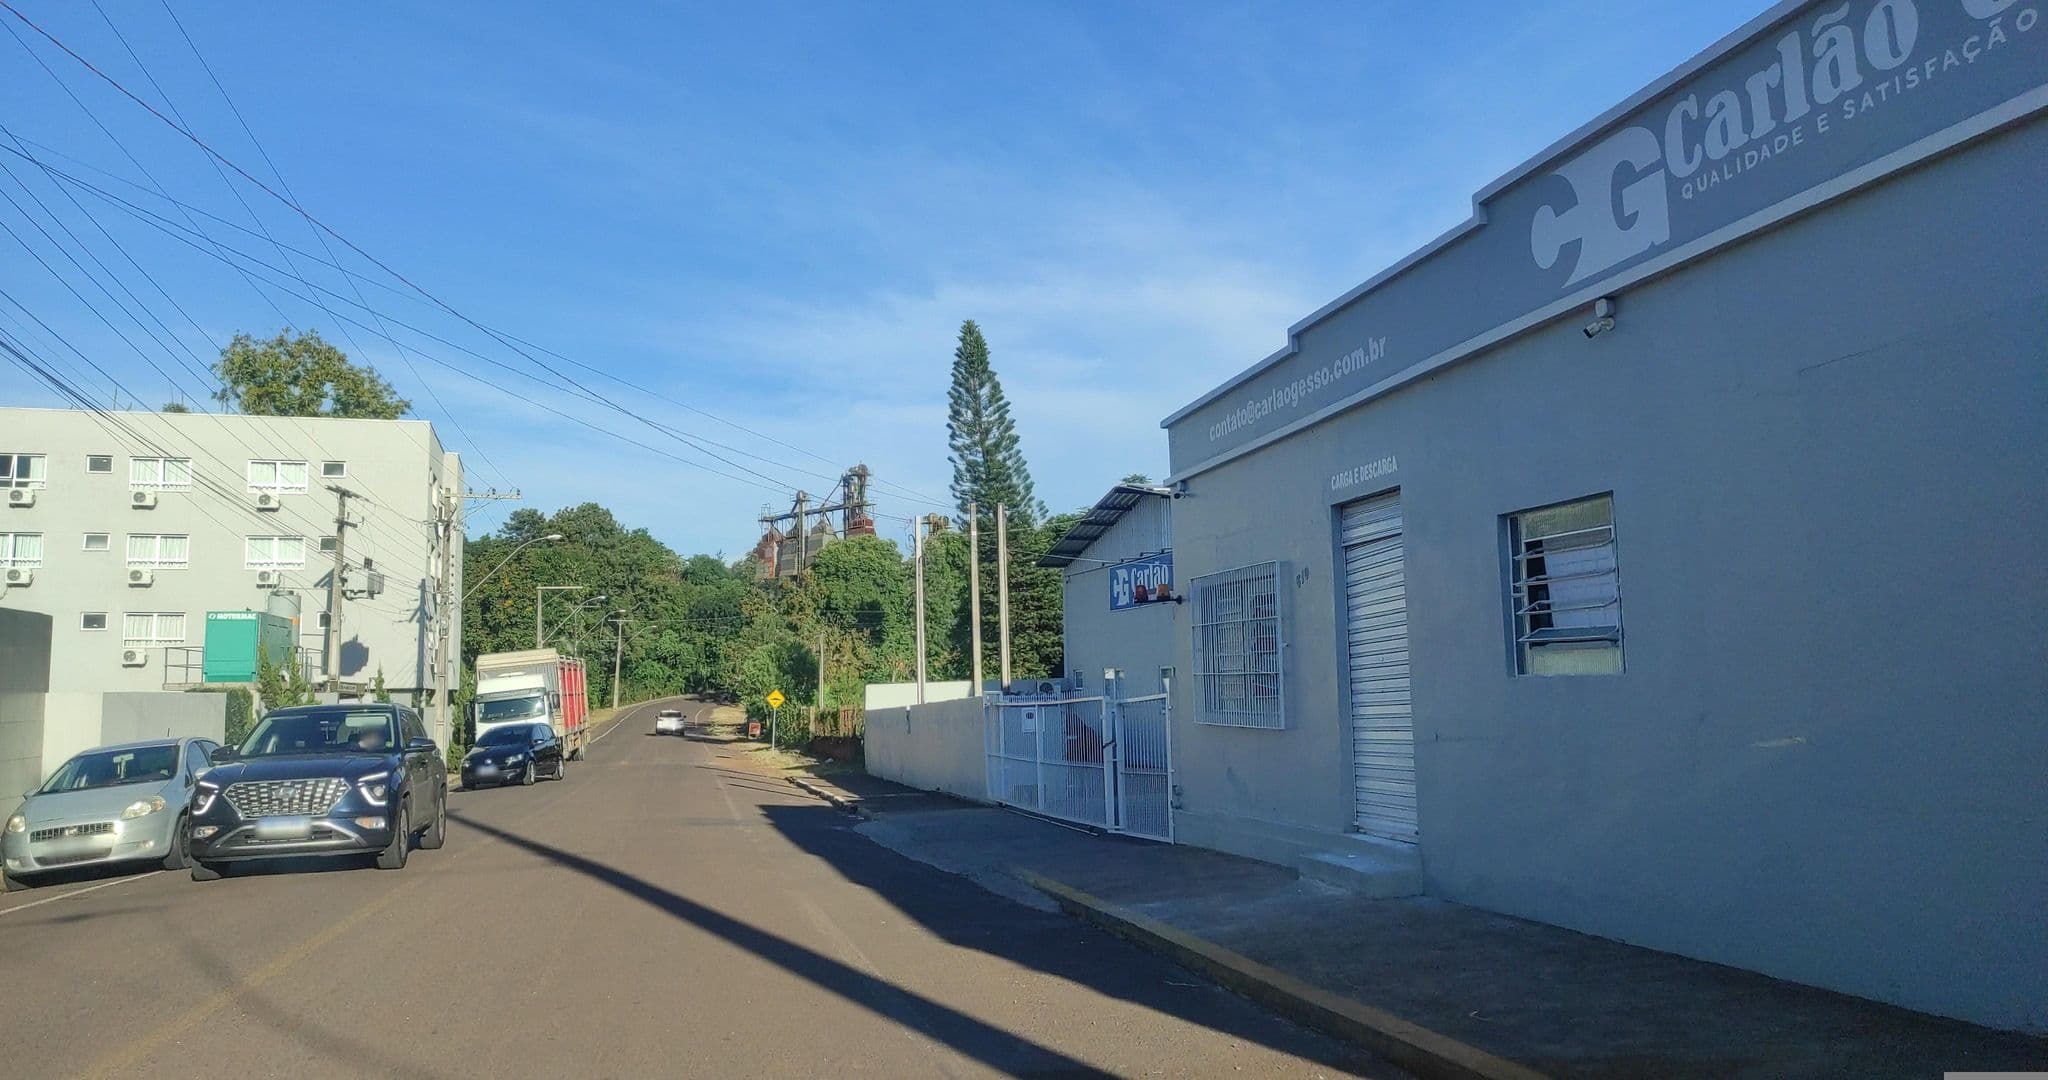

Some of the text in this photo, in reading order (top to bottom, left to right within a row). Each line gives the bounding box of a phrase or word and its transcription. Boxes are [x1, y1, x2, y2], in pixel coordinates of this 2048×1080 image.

[1664, 0, 1919, 178] Carlão
[1681, 8, 2038, 200] QUALIDADE E SATISFAÇÃO
[1209, 336, 1386, 442] contato@carlaogesso.com.br
[1331, 455, 1398, 490] CARGA E DESCARGA
